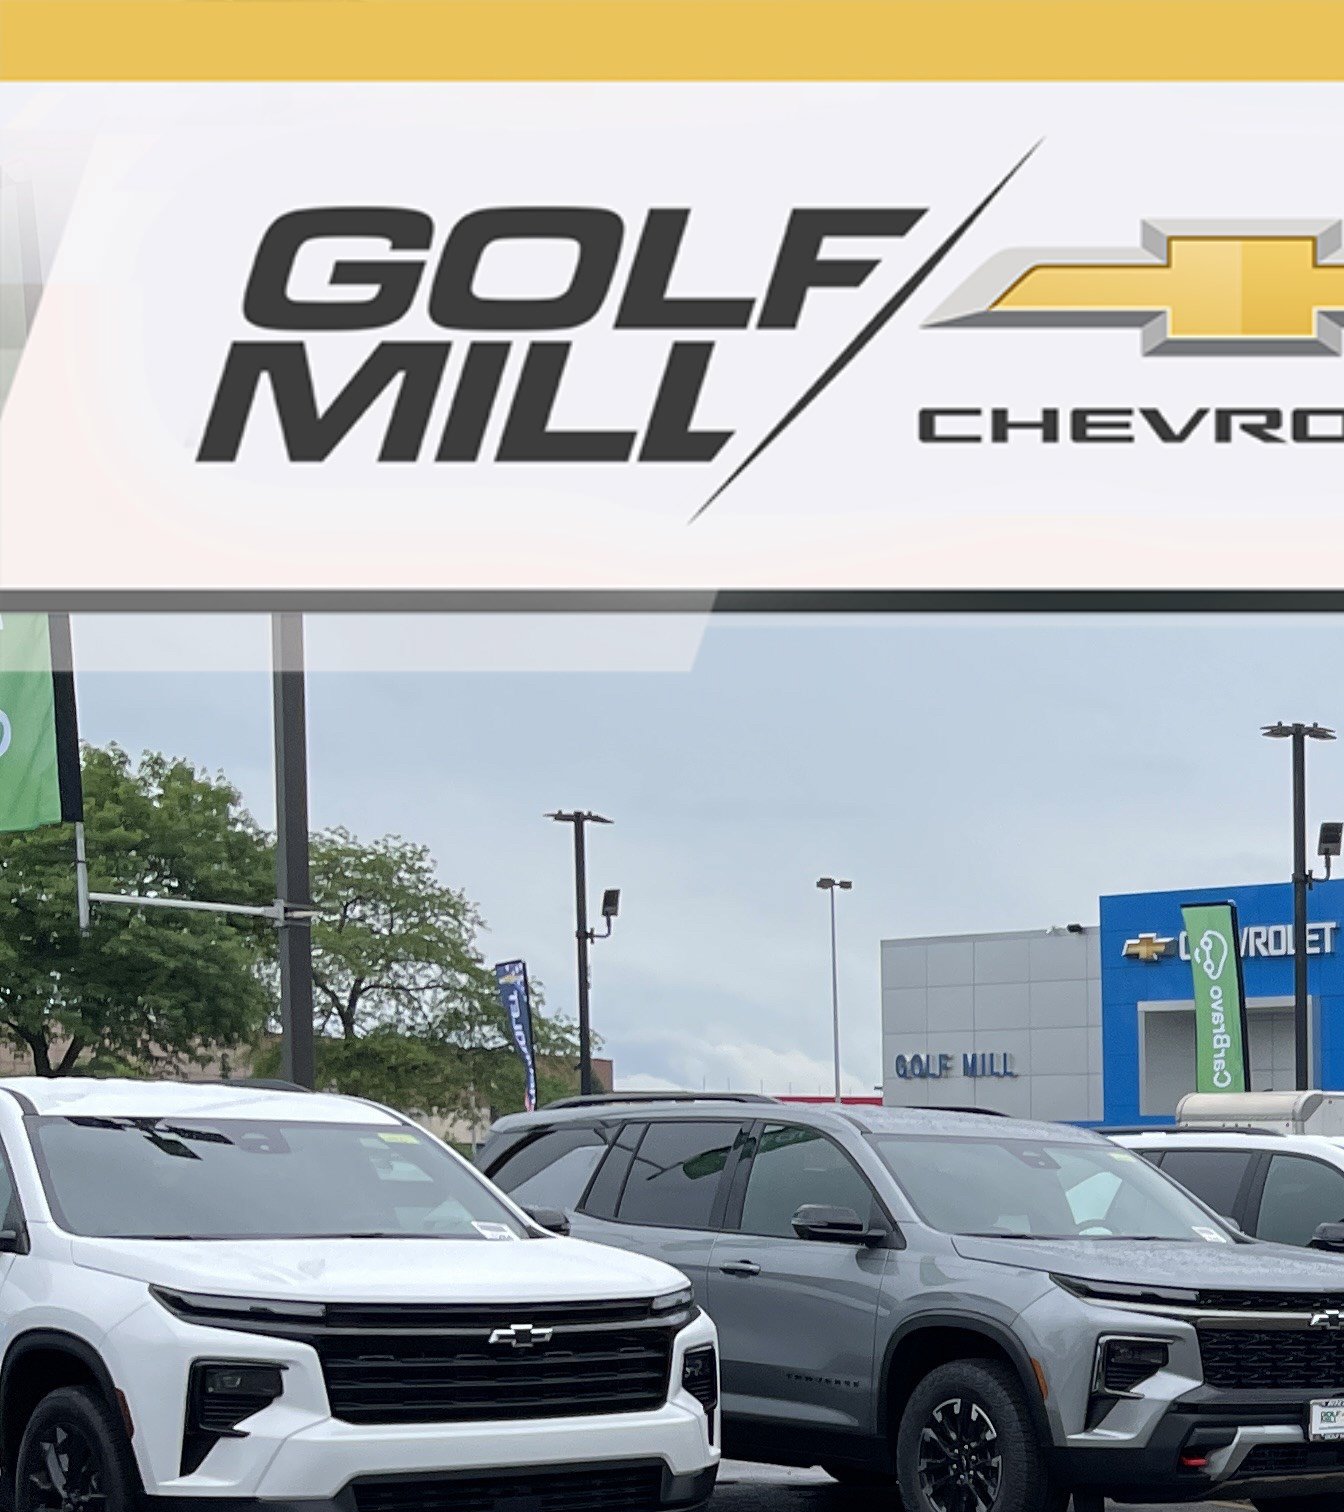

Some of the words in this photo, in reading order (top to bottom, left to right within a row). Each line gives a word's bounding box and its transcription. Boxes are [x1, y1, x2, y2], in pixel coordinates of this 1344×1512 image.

[1178, 921, 1337, 961] CVROLET
[896, 1053, 953, 1079] GOLF
[963, 1052, 1018, 1078] MILL
